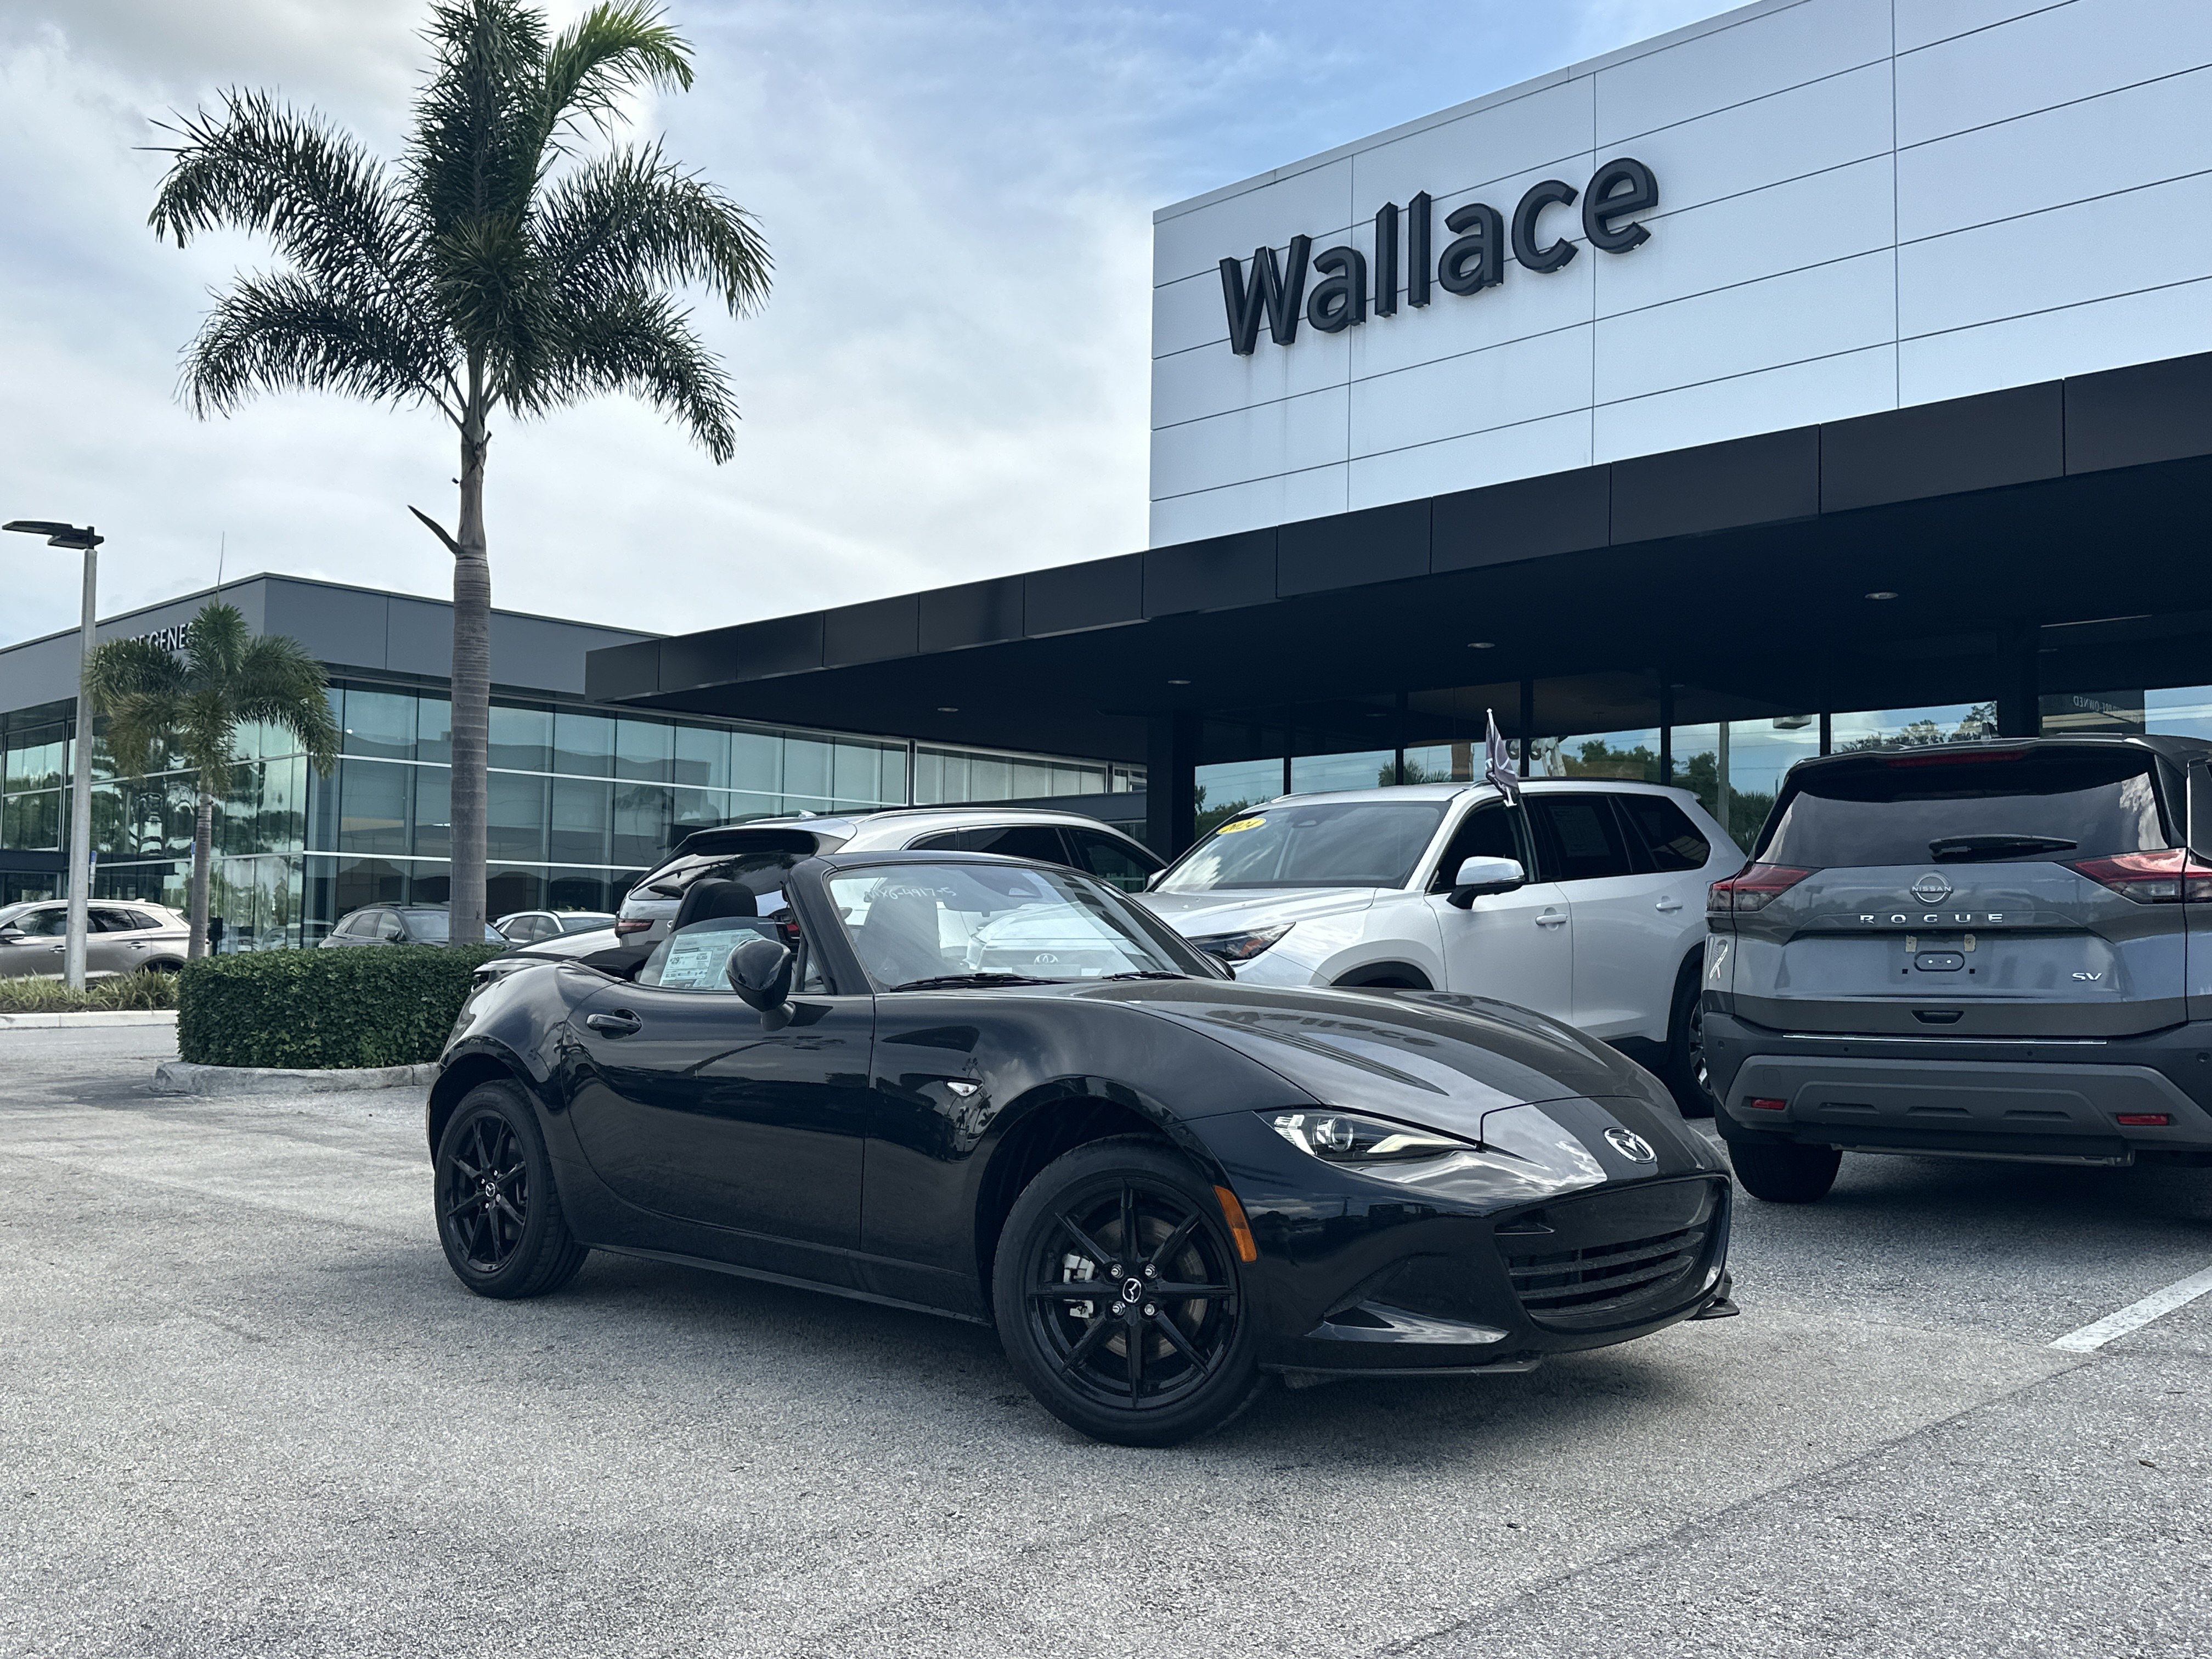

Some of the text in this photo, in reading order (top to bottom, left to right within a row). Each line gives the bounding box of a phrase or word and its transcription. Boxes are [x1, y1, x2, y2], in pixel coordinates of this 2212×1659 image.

[1219, 157, 1658, 356] Wallace
[149, 622, 198, 652] GENES
[1860, 913, 2003, 924] ROGUE
[2072, 972, 2102, 981] SV
